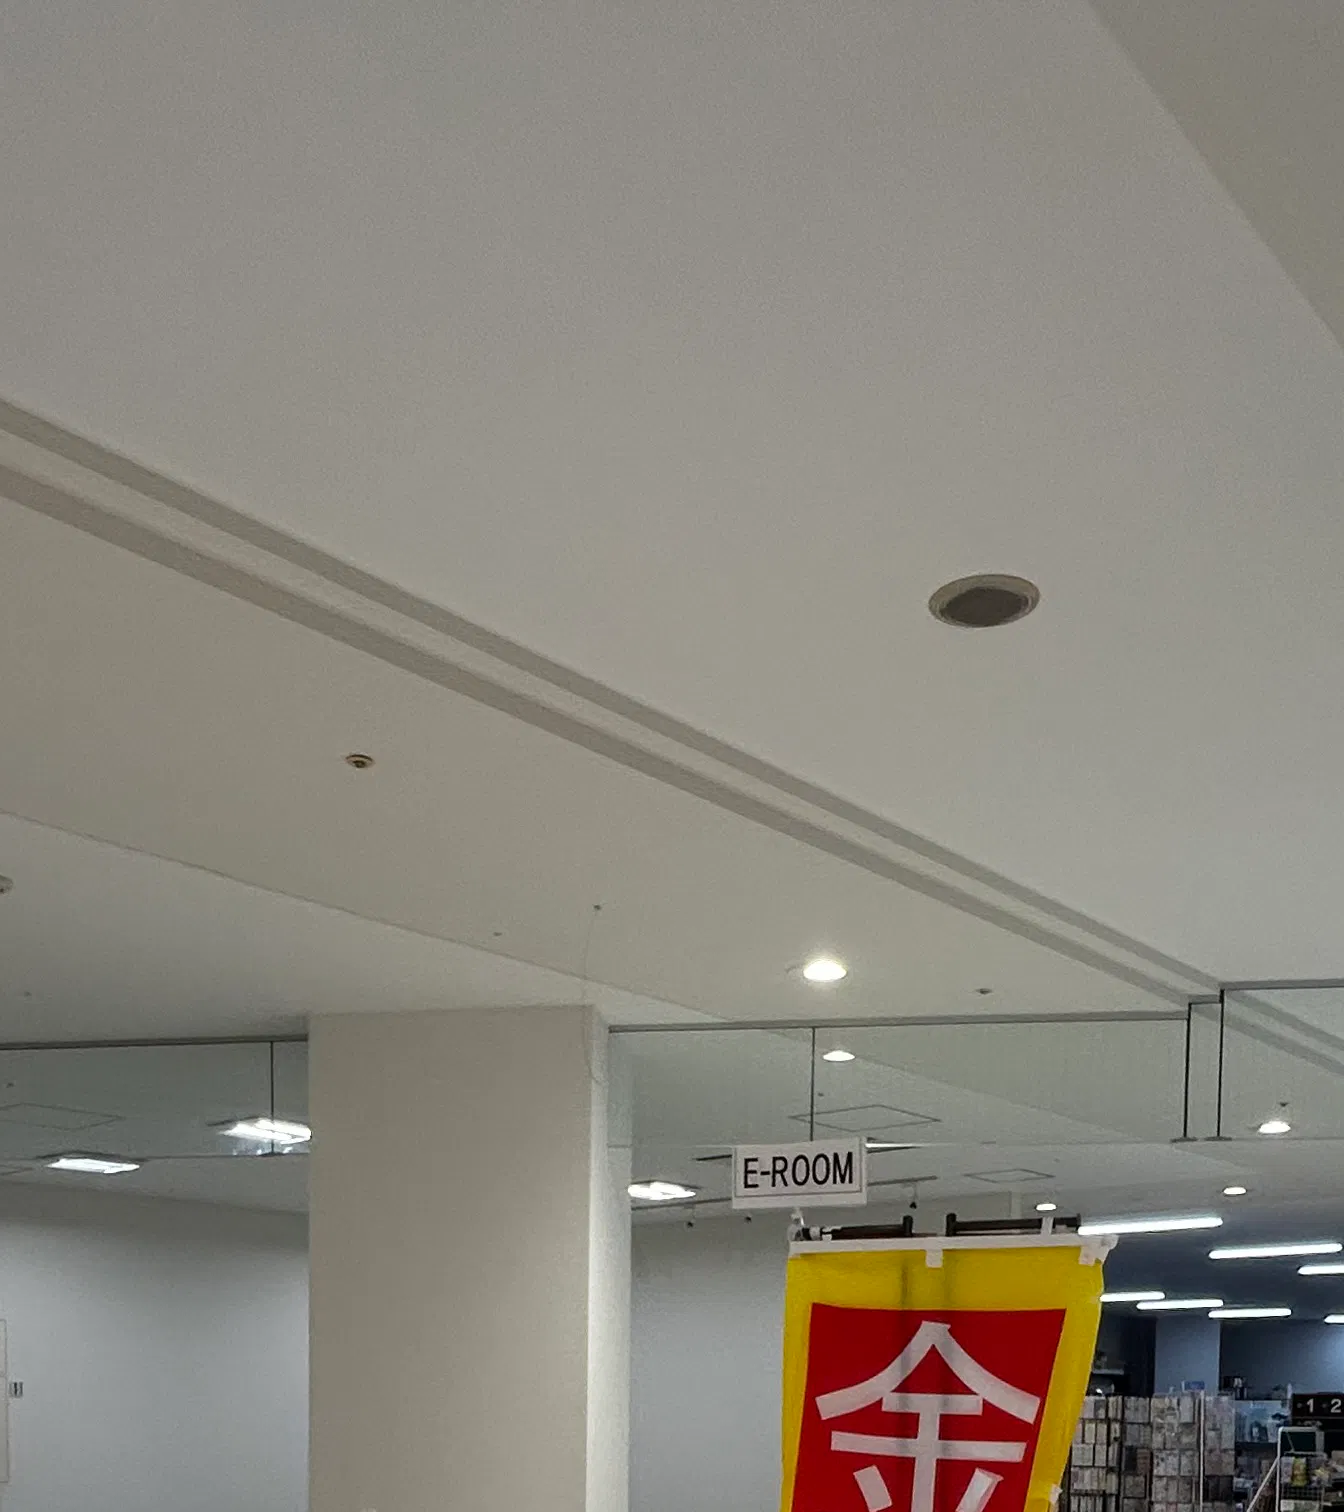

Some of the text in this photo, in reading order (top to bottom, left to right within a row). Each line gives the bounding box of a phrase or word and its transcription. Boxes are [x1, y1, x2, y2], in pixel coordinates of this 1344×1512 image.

[743, 1151, 854, 1188] E-ROOM
[1306, 1398, 1343, 1414] 1 2
